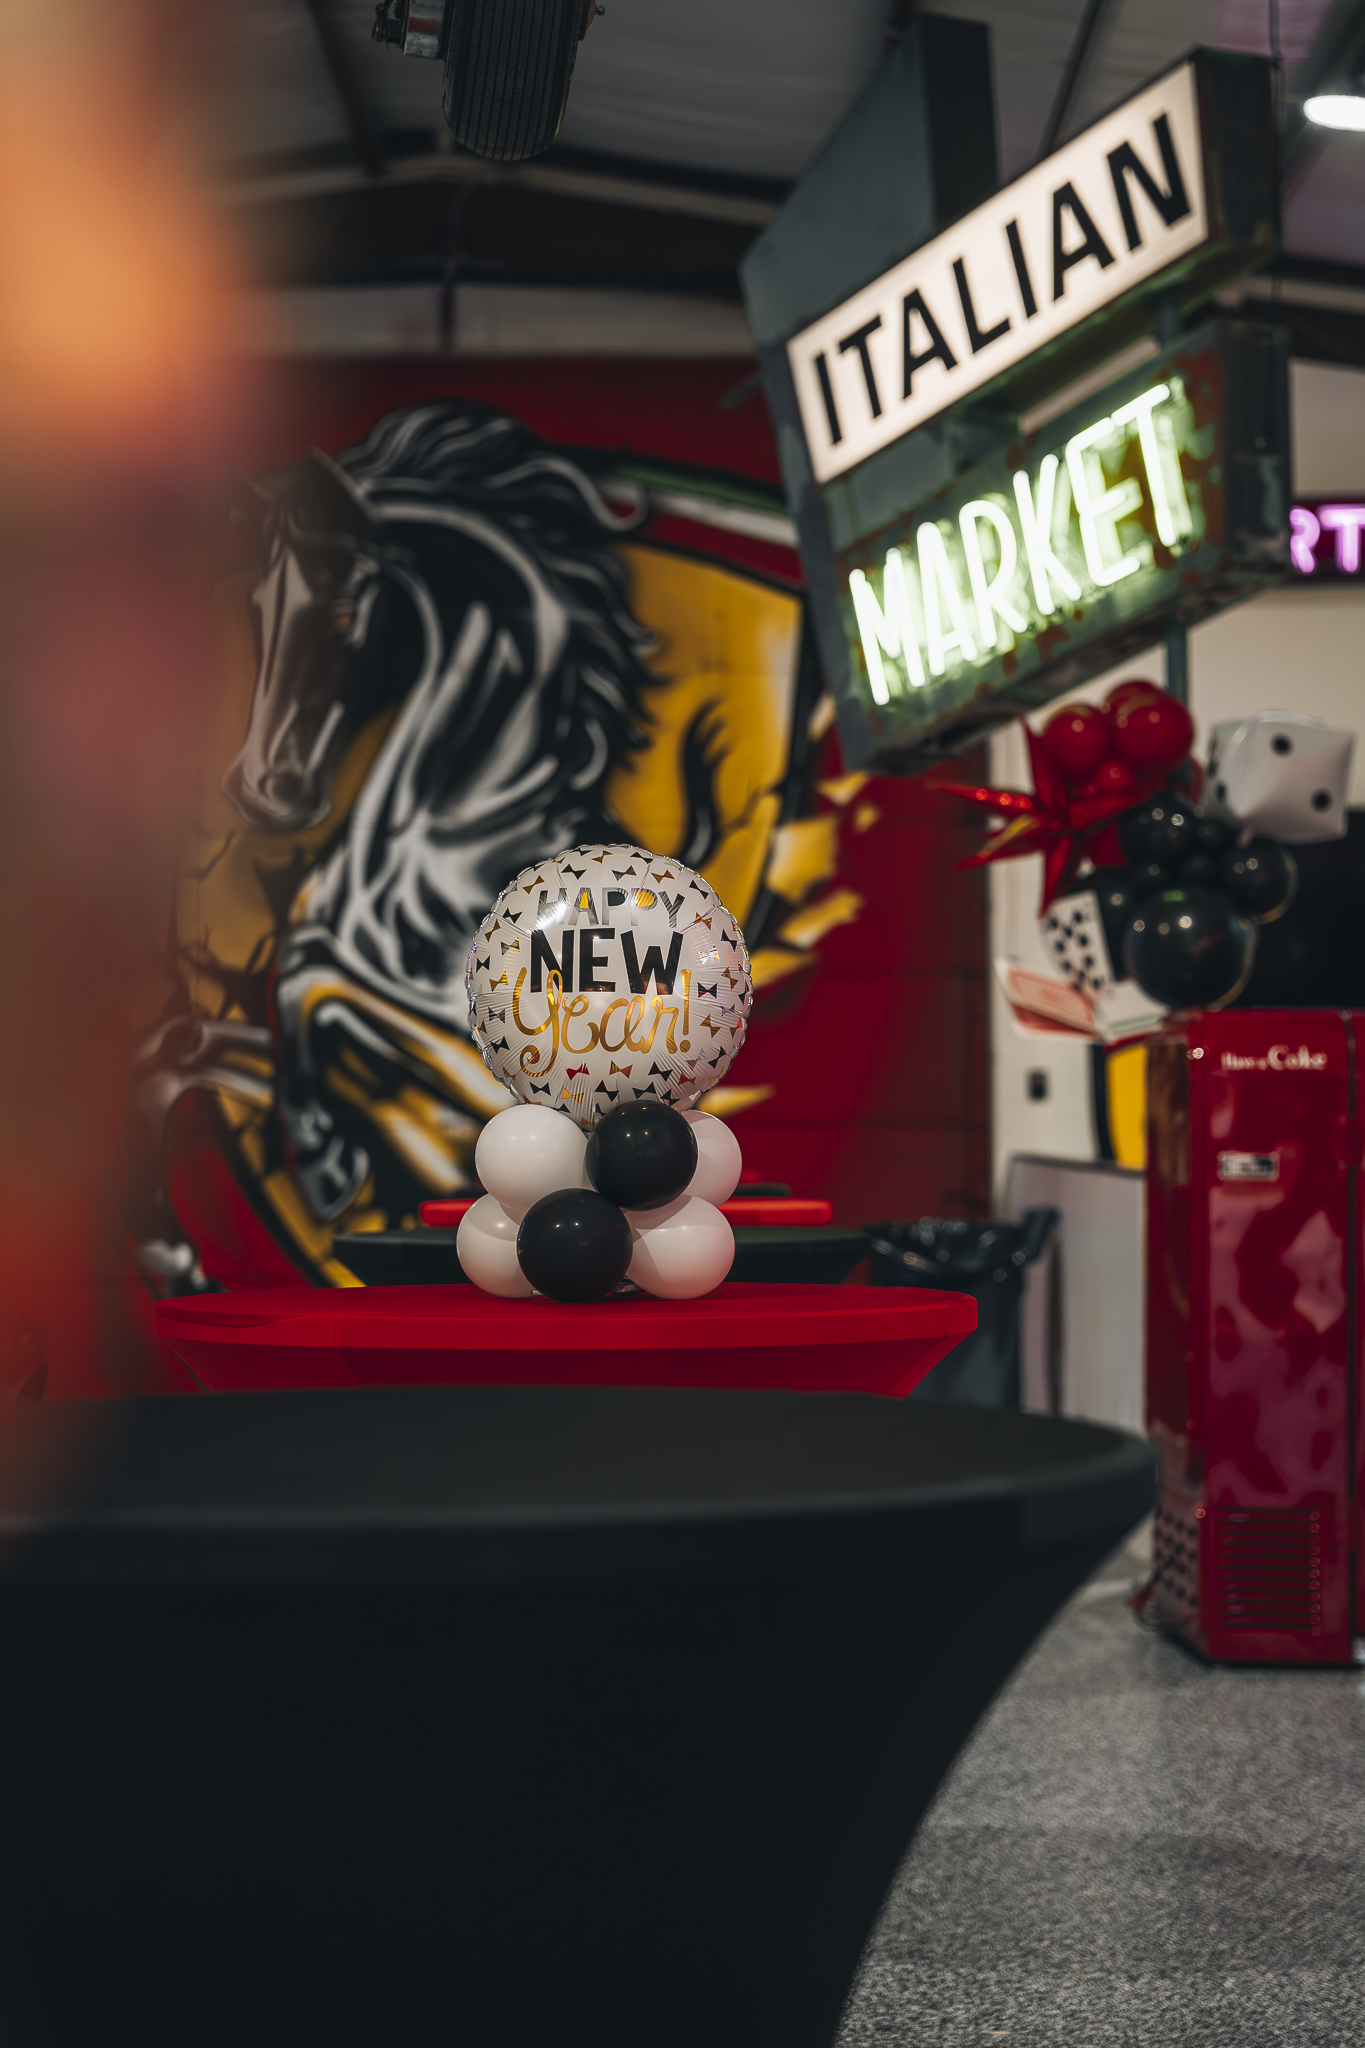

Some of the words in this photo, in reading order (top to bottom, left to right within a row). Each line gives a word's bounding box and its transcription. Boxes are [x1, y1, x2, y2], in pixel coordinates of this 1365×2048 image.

[813, 112, 1192, 447] ITALIAN
[848, 382, 1180, 706] MARKET
[530, 928, 684, 995] NEW
[536, 887, 686, 928] HAPPY
[512, 966, 692, 1077] Year!
